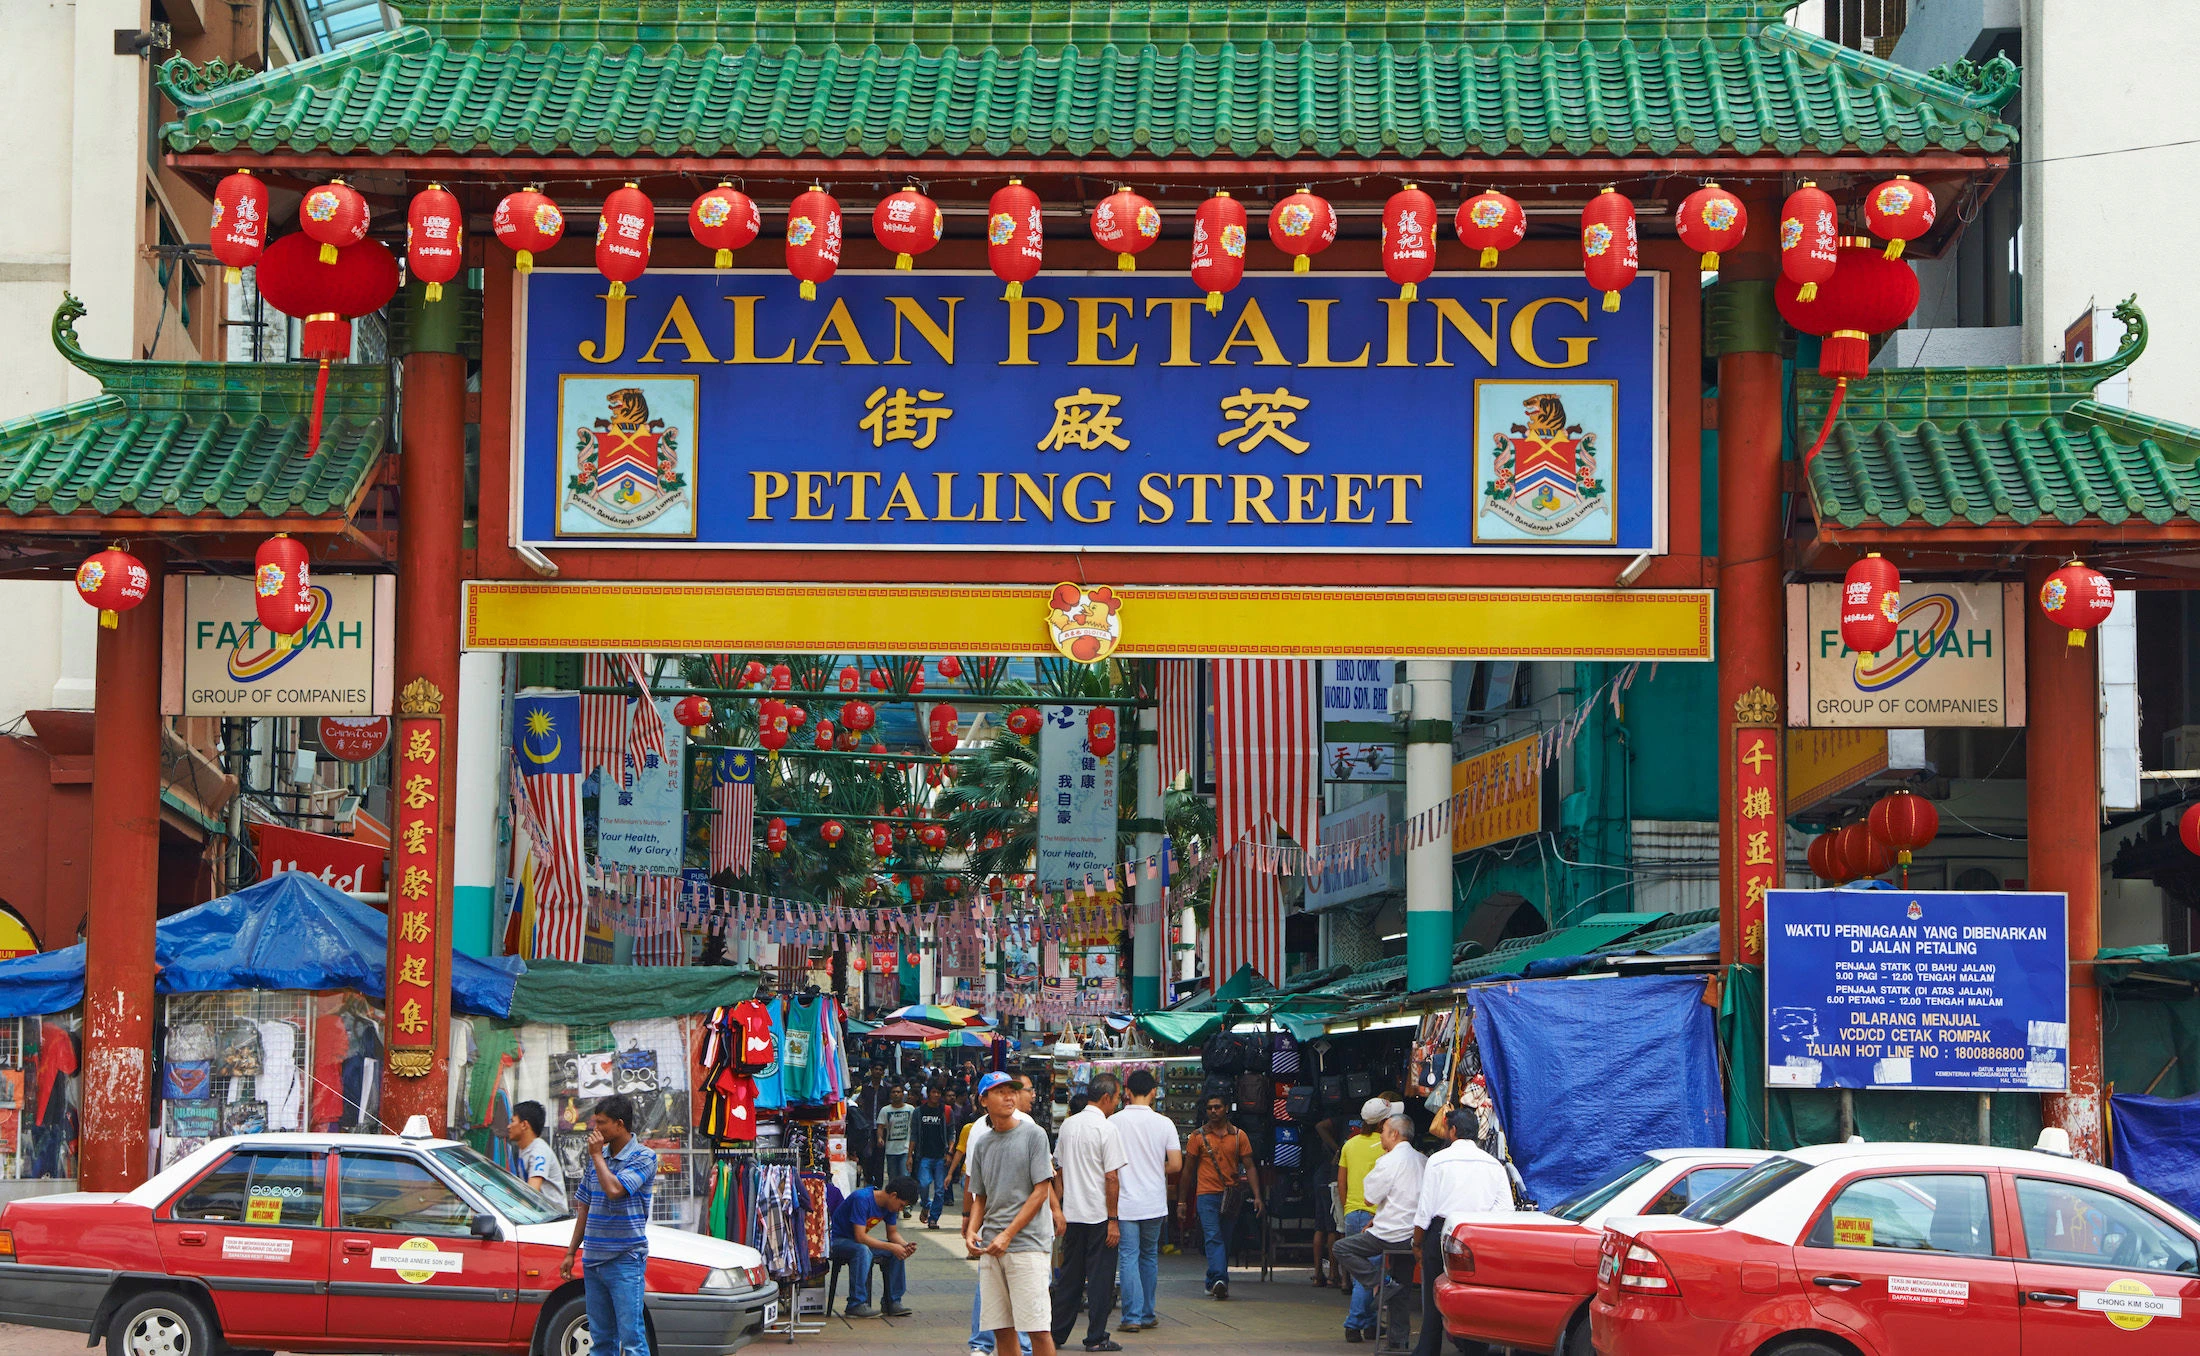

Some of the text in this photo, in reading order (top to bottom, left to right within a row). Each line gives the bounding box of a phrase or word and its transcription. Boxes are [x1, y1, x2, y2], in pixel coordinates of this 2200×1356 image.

[578, 296, 1598, 370] JALAN PETALING
[750, 471, 1422, 524] PETALING STREET
[1490, 500, 1514, 517] Dewan
[1556, 517, 1575, 528] Kuala
[1576, 498, 1600, 518] Lumpur
[197, 620, 362, 650] FATAH
[1821, 629, 1992, 659] FTUAH
[1336, 660, 1381, 681] HIRO COMIC
[192, 689, 366, 704] GROUP OF COMPANIES
[1324, 686, 1351, 708] WORLD
[1817, 699, 1998, 714] GROUP OF COMPANIES
[1057, 775, 1073, 824] 我自豪
[601, 832, 660, 843] Your Health,
[628, 846, 642, 855] My
[645, 846, 672, 857] Glory
[1042, 849, 1097, 860] Your Health,
[1068, 862, 1081, 871] My
[1083, 861, 1108, 872] Glory
[272, 858, 365, 894] tel
[1785, 924, 2047, 941] WAKTU PERNIAGAAN YANG DIBENARKAN
[1851, 940, 1977, 955] DI JALAN PETALING
[1835, 962, 1996, 974] PENJAJA STATIK (DI BAHU JALAN)
[1835, 972, 1995, 983] 9.00 PAGI 12.00 TENGAH MALAM
[1835, 985, 1993, 997] PENJAJA STATIK (DI ATAS JALAN)
[1826, 995, 2004, 1007] 6.00 PETANG 12.00 TENGAH MALAM
[1850, 1011, 1981, 1027] DILARANG MENJUAL
[1839, 1027, 1991, 1044] VCD/CD CETAK ROMPAK
[1806, 1043, 1852, 1058] TALIAN
[1855, 1044, 1883, 1058] HOT
[1887, 1045, 1914, 1059] LINE
[1919, 1045, 1939, 1059] NO
[1954, 1046, 2025, 1061] 1800886800
[534, 1156, 546, 1172] 2
[253, 1210, 275, 1220] WELCOME
[1836, 1220, 1871, 1231] JEMPUT NAIK
[1841, 1233, 1866, 1243] WELCOME
[380, 1256, 408, 1264] METROCAB
[1912, 1279, 1950, 1287] MENGGUNAKAN
[1910, 1286, 1938, 1294] MENAWAR
[1938, 1289, 1967, 1297] DILARANG
[1892, 1294, 1921, 1302] DAPATKAN
[1938, 1297, 1965, 1306] TAMBANG
[2097, 1298, 2125, 1307] CHONG
[2144, 1301, 2164, 1310] SOOI
